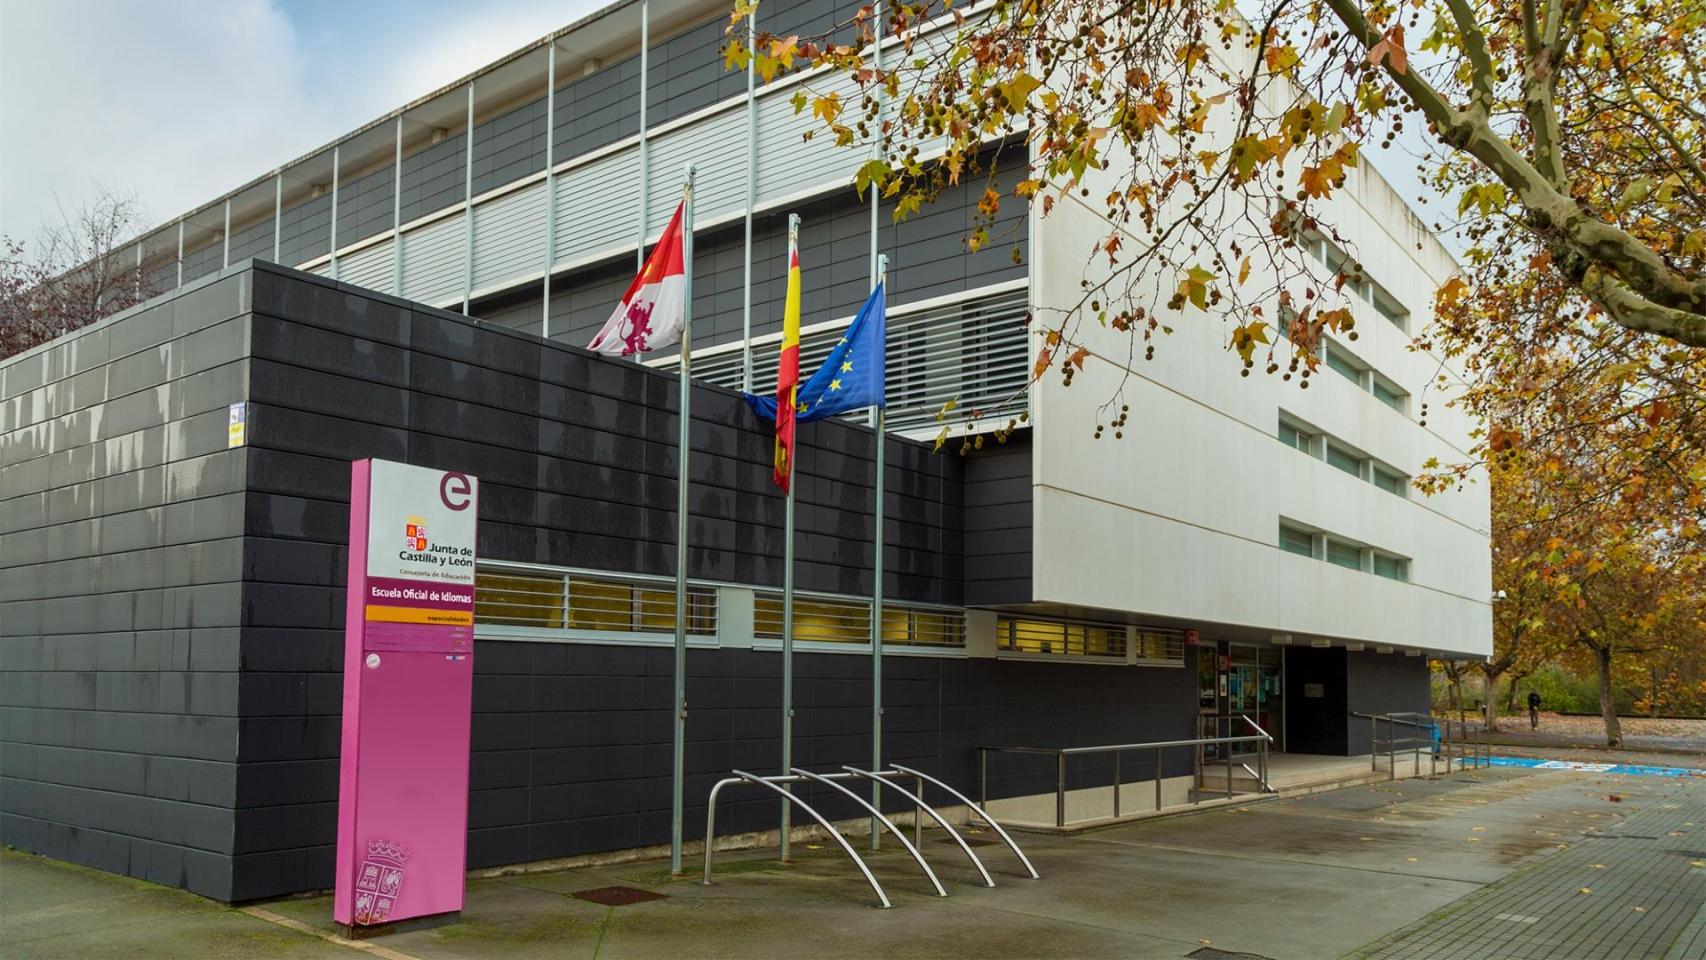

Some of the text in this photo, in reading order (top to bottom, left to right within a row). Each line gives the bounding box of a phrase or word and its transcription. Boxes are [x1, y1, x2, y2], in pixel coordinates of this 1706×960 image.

[440, 470, 471, 511] e
[429, 543, 472, 556] Junta de
[399, 551, 473, 567] Castilla y León
[371, 587, 472, 603] Escuela Oficial de Idiomas
